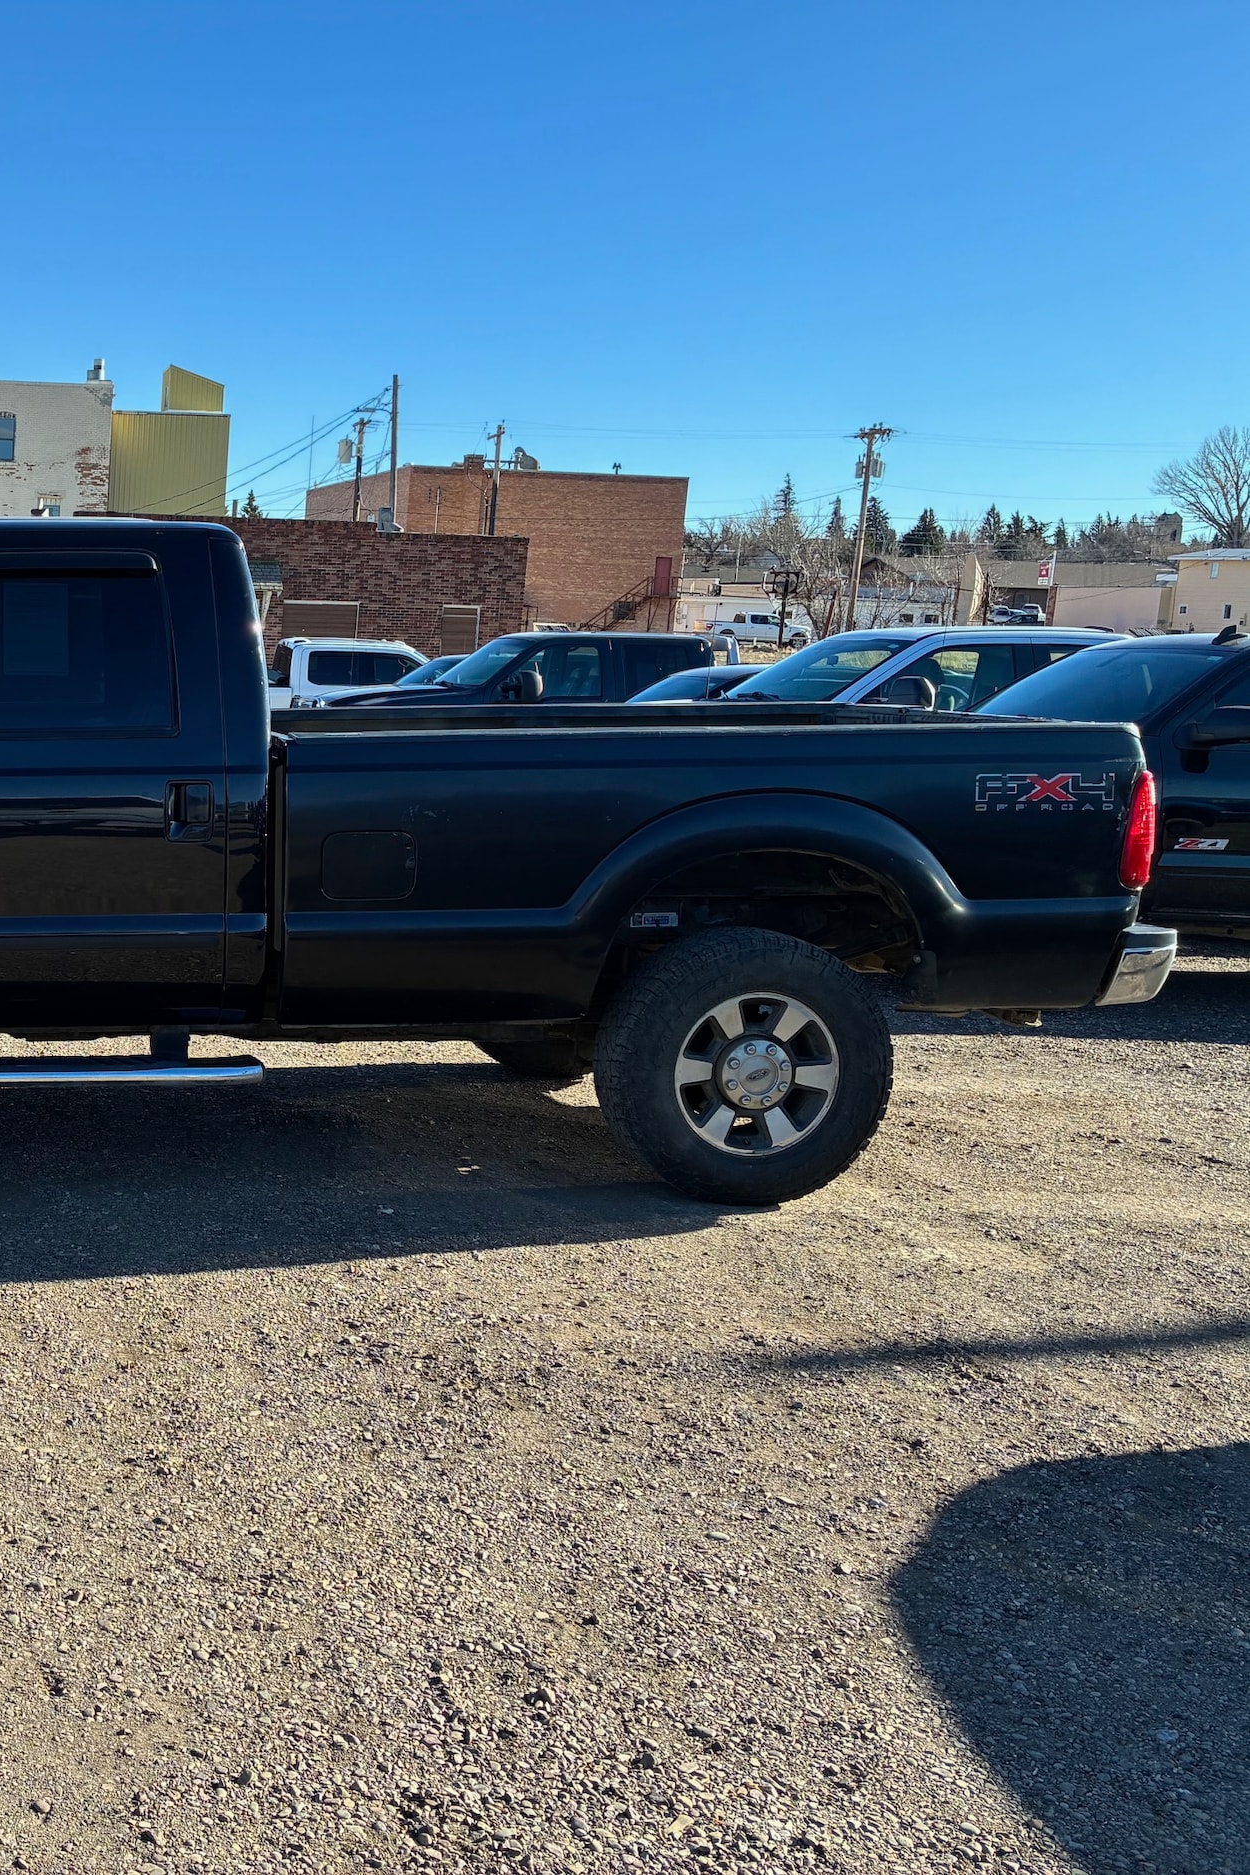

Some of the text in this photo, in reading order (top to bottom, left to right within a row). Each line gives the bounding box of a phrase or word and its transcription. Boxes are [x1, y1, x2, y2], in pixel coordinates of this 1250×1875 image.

[974, 773, 1116, 802] FX4
[974, 803, 1115, 812] OFF ROAD
